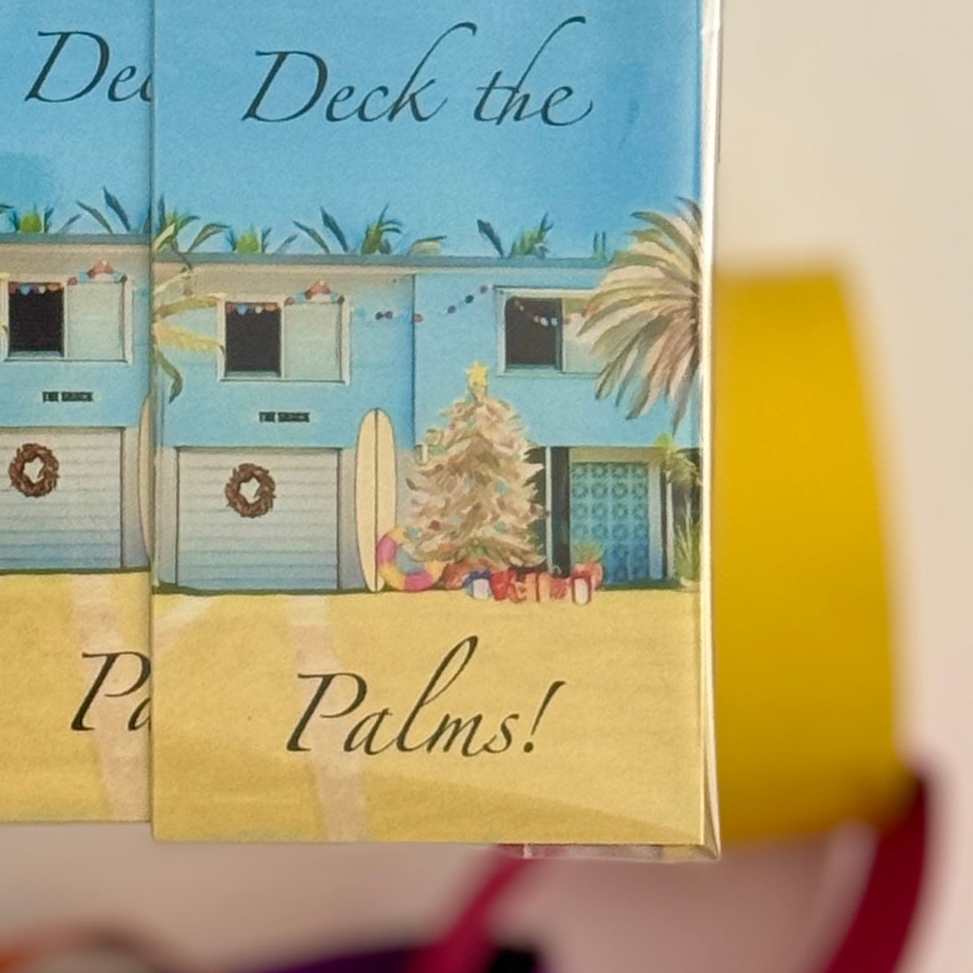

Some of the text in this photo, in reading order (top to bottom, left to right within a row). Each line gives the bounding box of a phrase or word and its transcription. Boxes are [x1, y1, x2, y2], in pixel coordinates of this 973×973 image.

[24, 30, 153, 104] De
[240, 15, 594, 127] Deck the
[285, 635, 567, 758] Palms!
